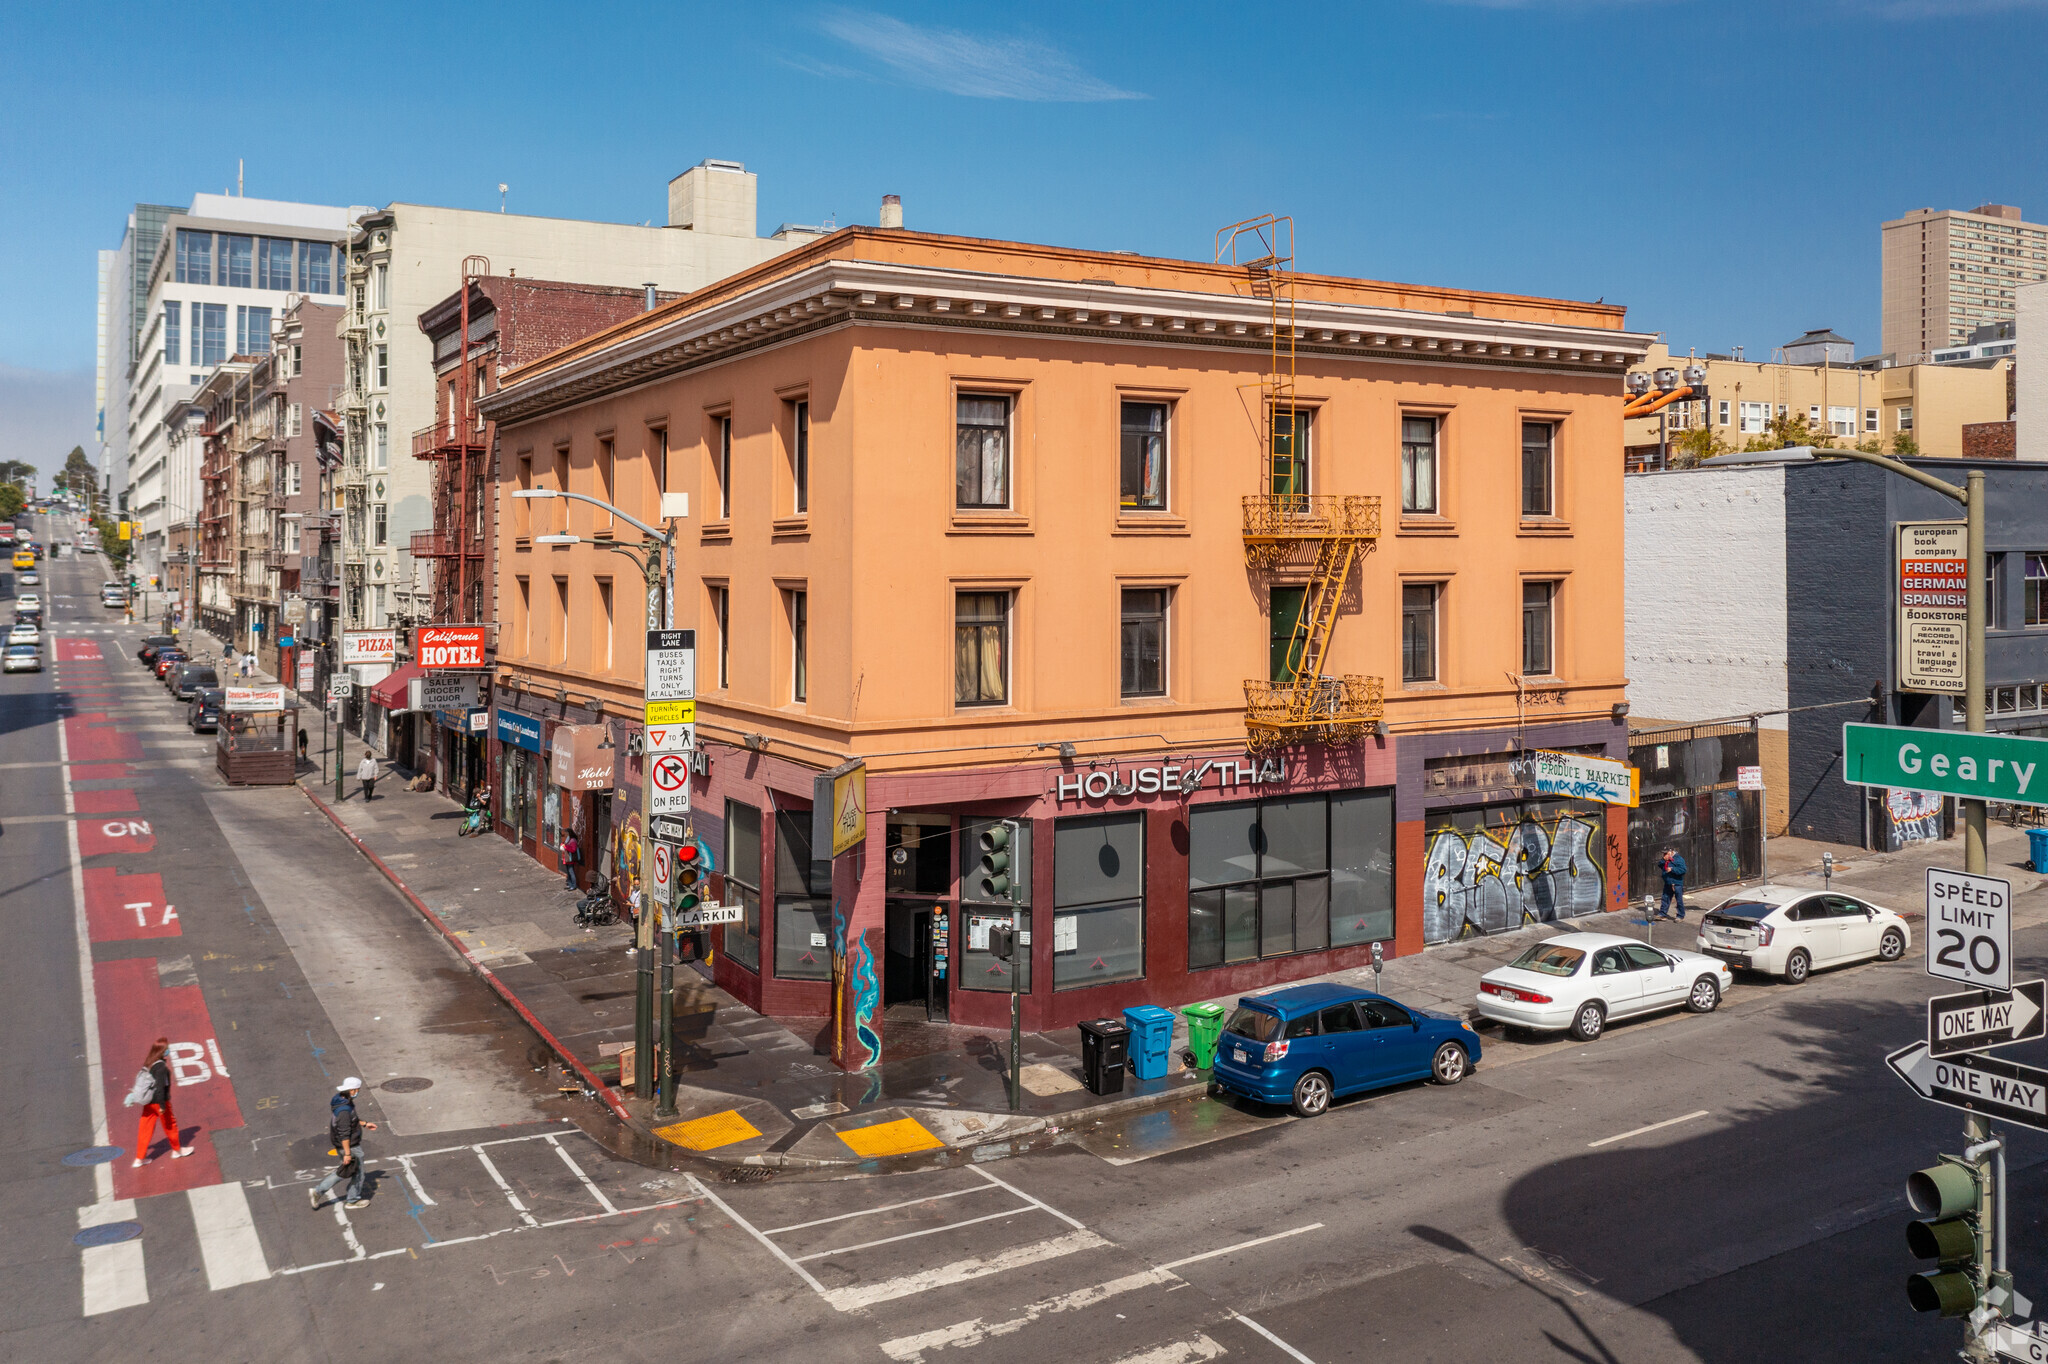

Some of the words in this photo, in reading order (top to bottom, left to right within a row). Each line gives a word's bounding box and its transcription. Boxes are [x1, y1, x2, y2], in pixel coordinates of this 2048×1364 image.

[1905, 562, 1965, 573] FRENCH
[1903, 578, 1966, 589] GERMAN
[1903, 594, 1966, 605] SPANISH
[1907, 611, 1967, 620] BOOKSTORE
[423, 631, 479, 644] California
[358, 638, 394, 652] PIZZA
[421, 646, 480, 665] HOTEL
[1917, 658, 1957, 666] language
[334, 686, 349, 694] 20
[1930, 680, 1964, 688] FLOORS
[578, 766, 611, 779] Hotel
[1540, 763, 1580, 779] PRODUCE
[1586, 769, 1631, 786] MARKET
[1898, 742, 2036, 794] Geary
[586, 780, 603, 788] 910
[1057, 765, 1181, 800] HOUSE
[1212, 758, 1285, 786] THAI
[654, 798, 665, 807] ON
[670, 796, 686, 805] RED
[660, 823, 670, 833] ONE
[671, 824, 682, 836] WAY
[655, 886, 660, 896] ON
[1934, 882, 2003, 908] SPEED
[683, 910, 736, 924] LARKIN
[1941, 905, 1995, 929] LIMIT
[1936, 928, 2000, 975] 20
[1944, 1010, 1975, 1037] ONE
[1982, 1004, 2013, 1030] WAY
[1936, 1065, 1981, 1094] ONE
[1990, 1077, 2039, 1108] WAY
